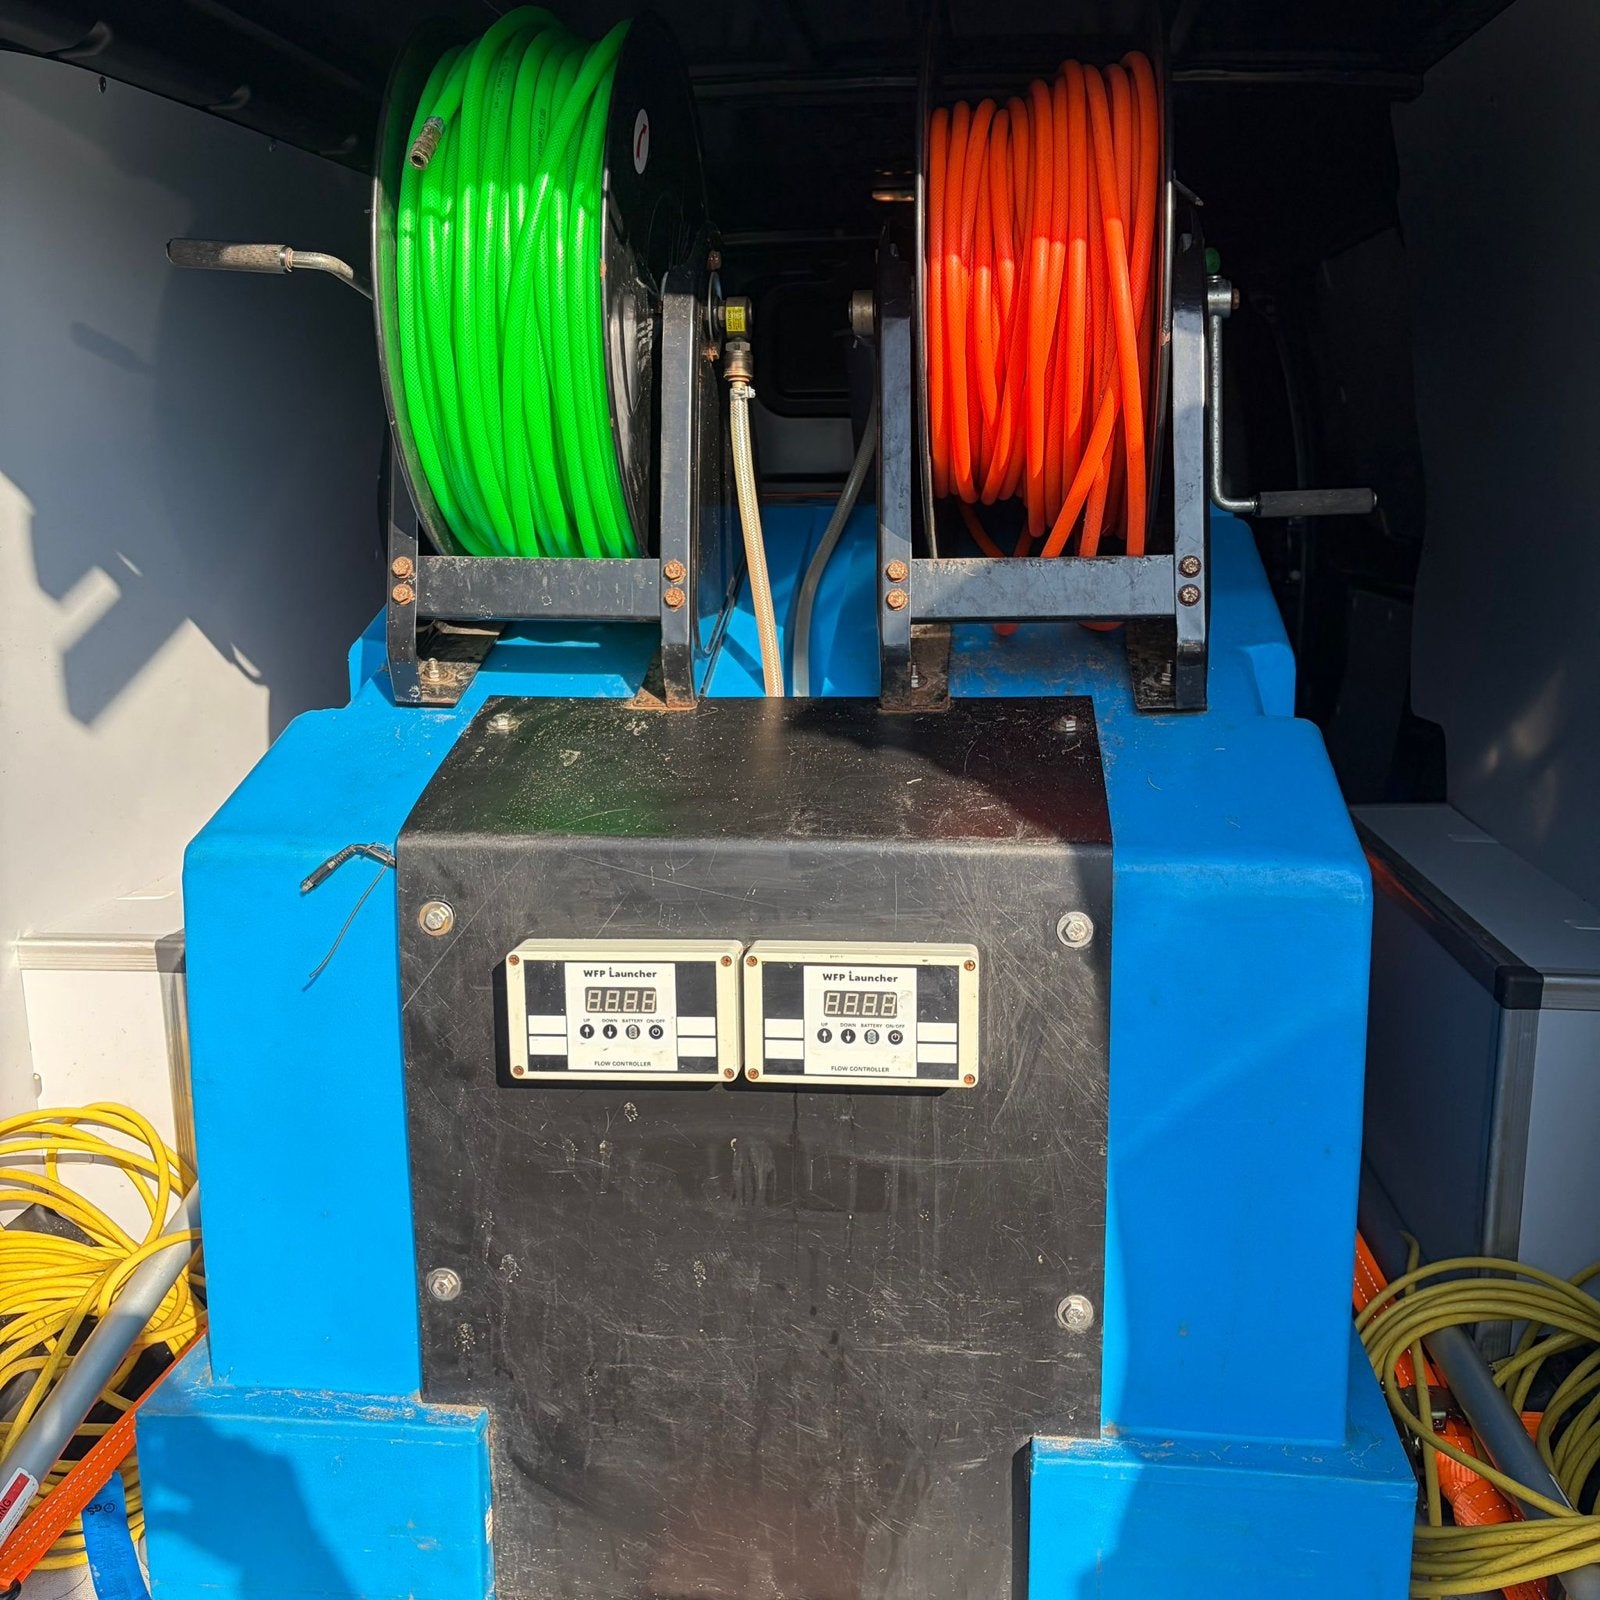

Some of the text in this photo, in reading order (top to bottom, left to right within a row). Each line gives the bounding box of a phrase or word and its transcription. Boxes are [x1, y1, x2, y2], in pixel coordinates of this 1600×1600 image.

[583, 966, 657, 978] WFP Launcher
[822, 970, 898, 983] WFP Launcher
